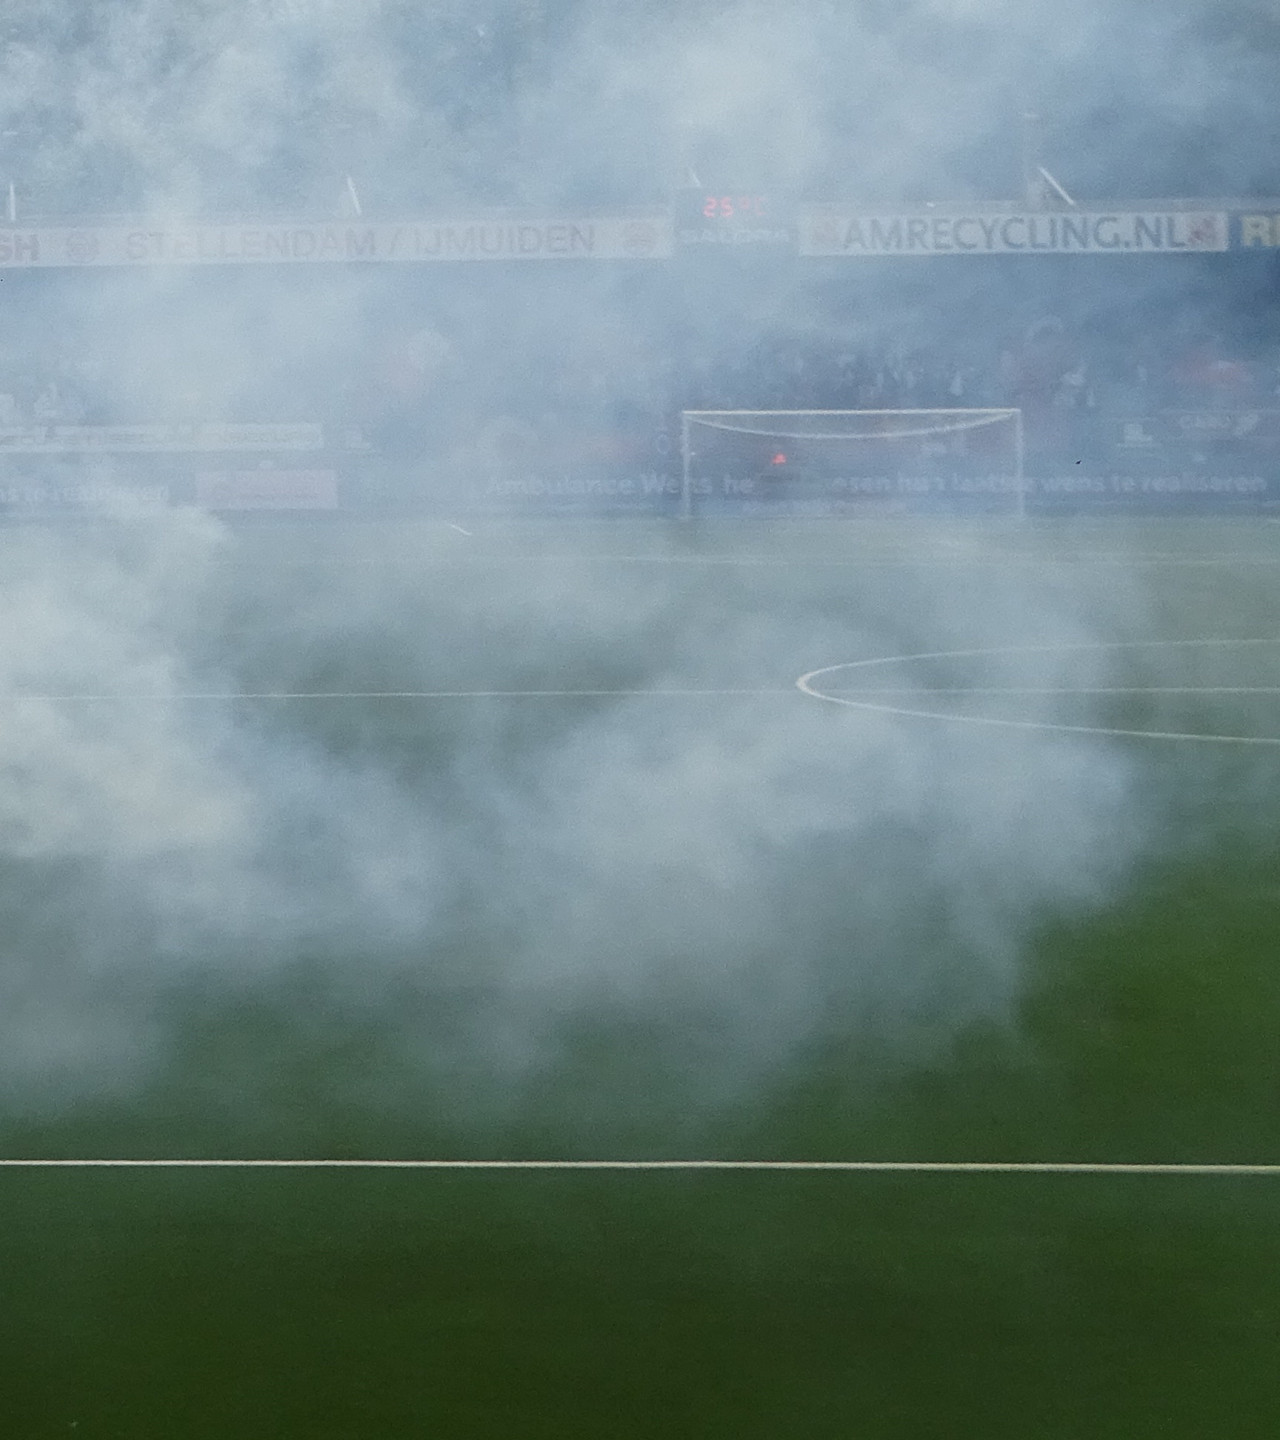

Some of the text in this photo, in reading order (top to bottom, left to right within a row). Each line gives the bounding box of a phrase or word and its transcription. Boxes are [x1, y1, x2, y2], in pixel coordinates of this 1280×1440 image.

[125, 228, 376, 259] STELLENDAM
[414, 224, 596, 256] IJMUIDEN
[843, 215, 1185, 251] AMRECYCLING.NL
